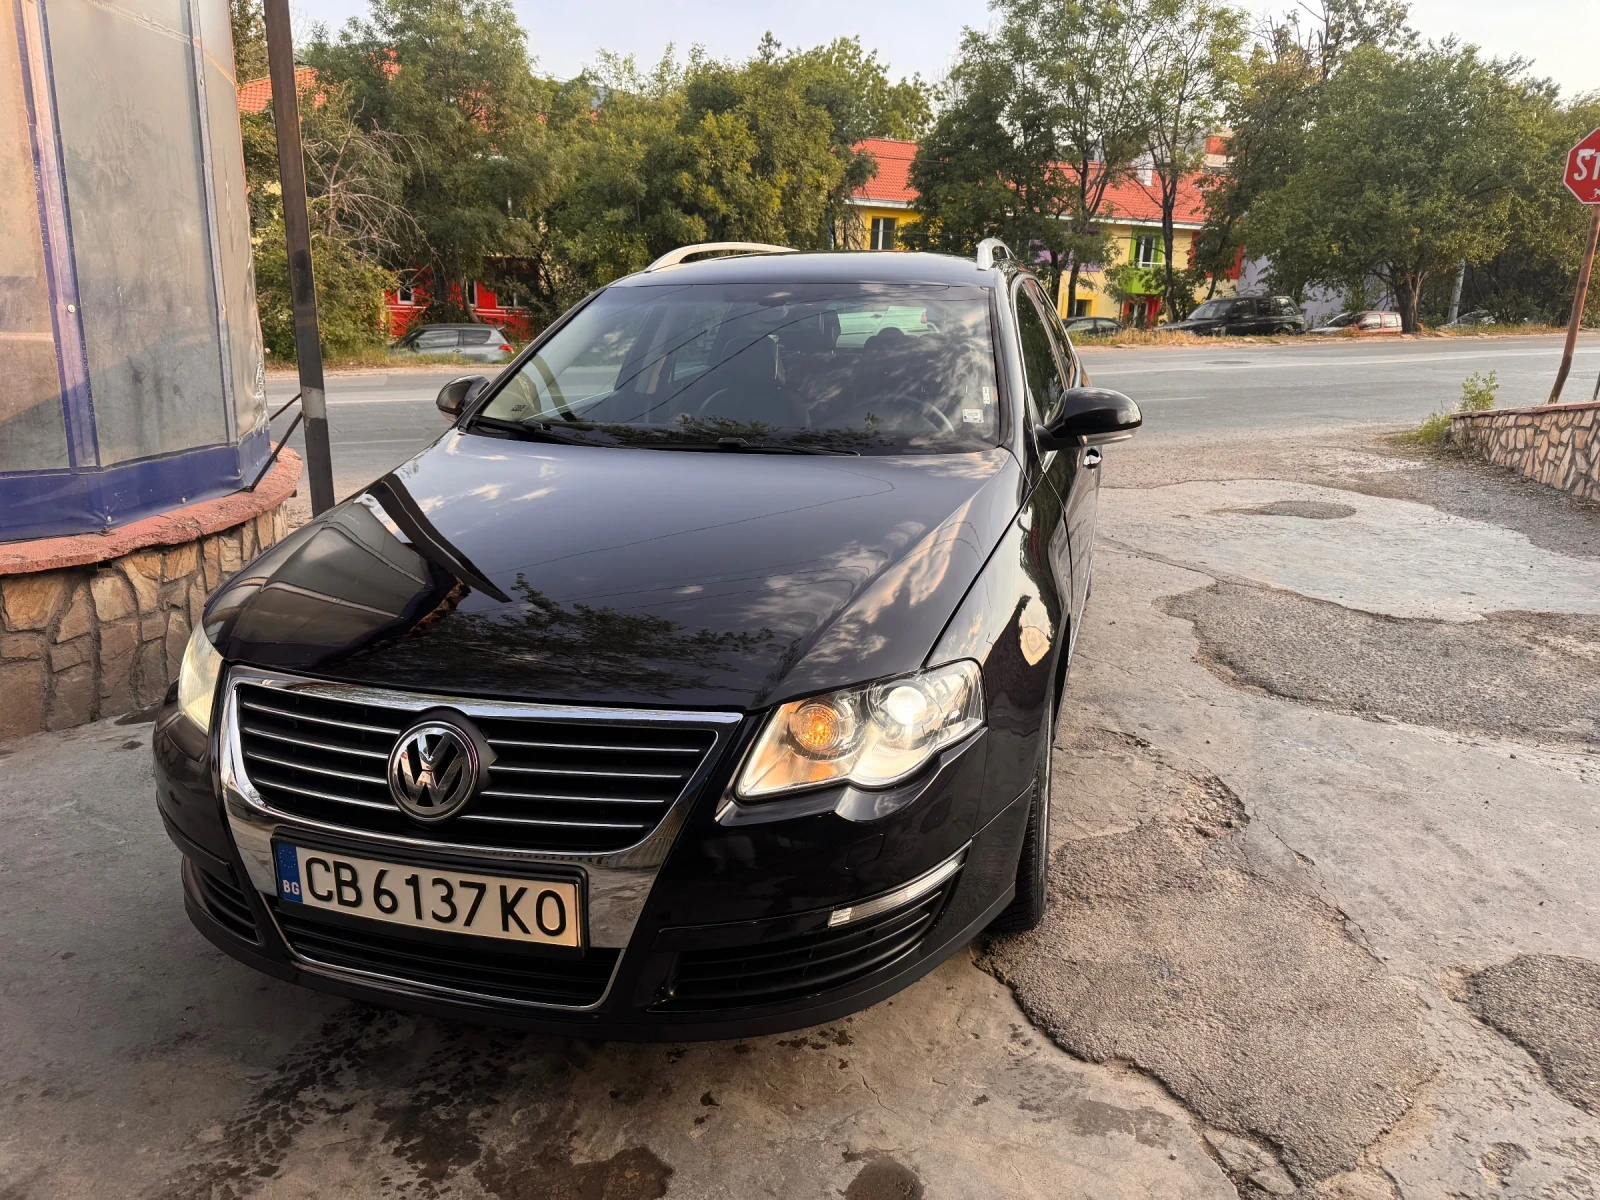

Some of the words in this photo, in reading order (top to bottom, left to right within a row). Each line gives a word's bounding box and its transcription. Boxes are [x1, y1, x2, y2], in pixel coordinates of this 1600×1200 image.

[392, 726, 471, 816] VW
[283, 880, 300, 895] BG
[305, 857, 362, 908] CB
[373, 869, 486, 927] 6137
[499, 885, 567, 937] KO
